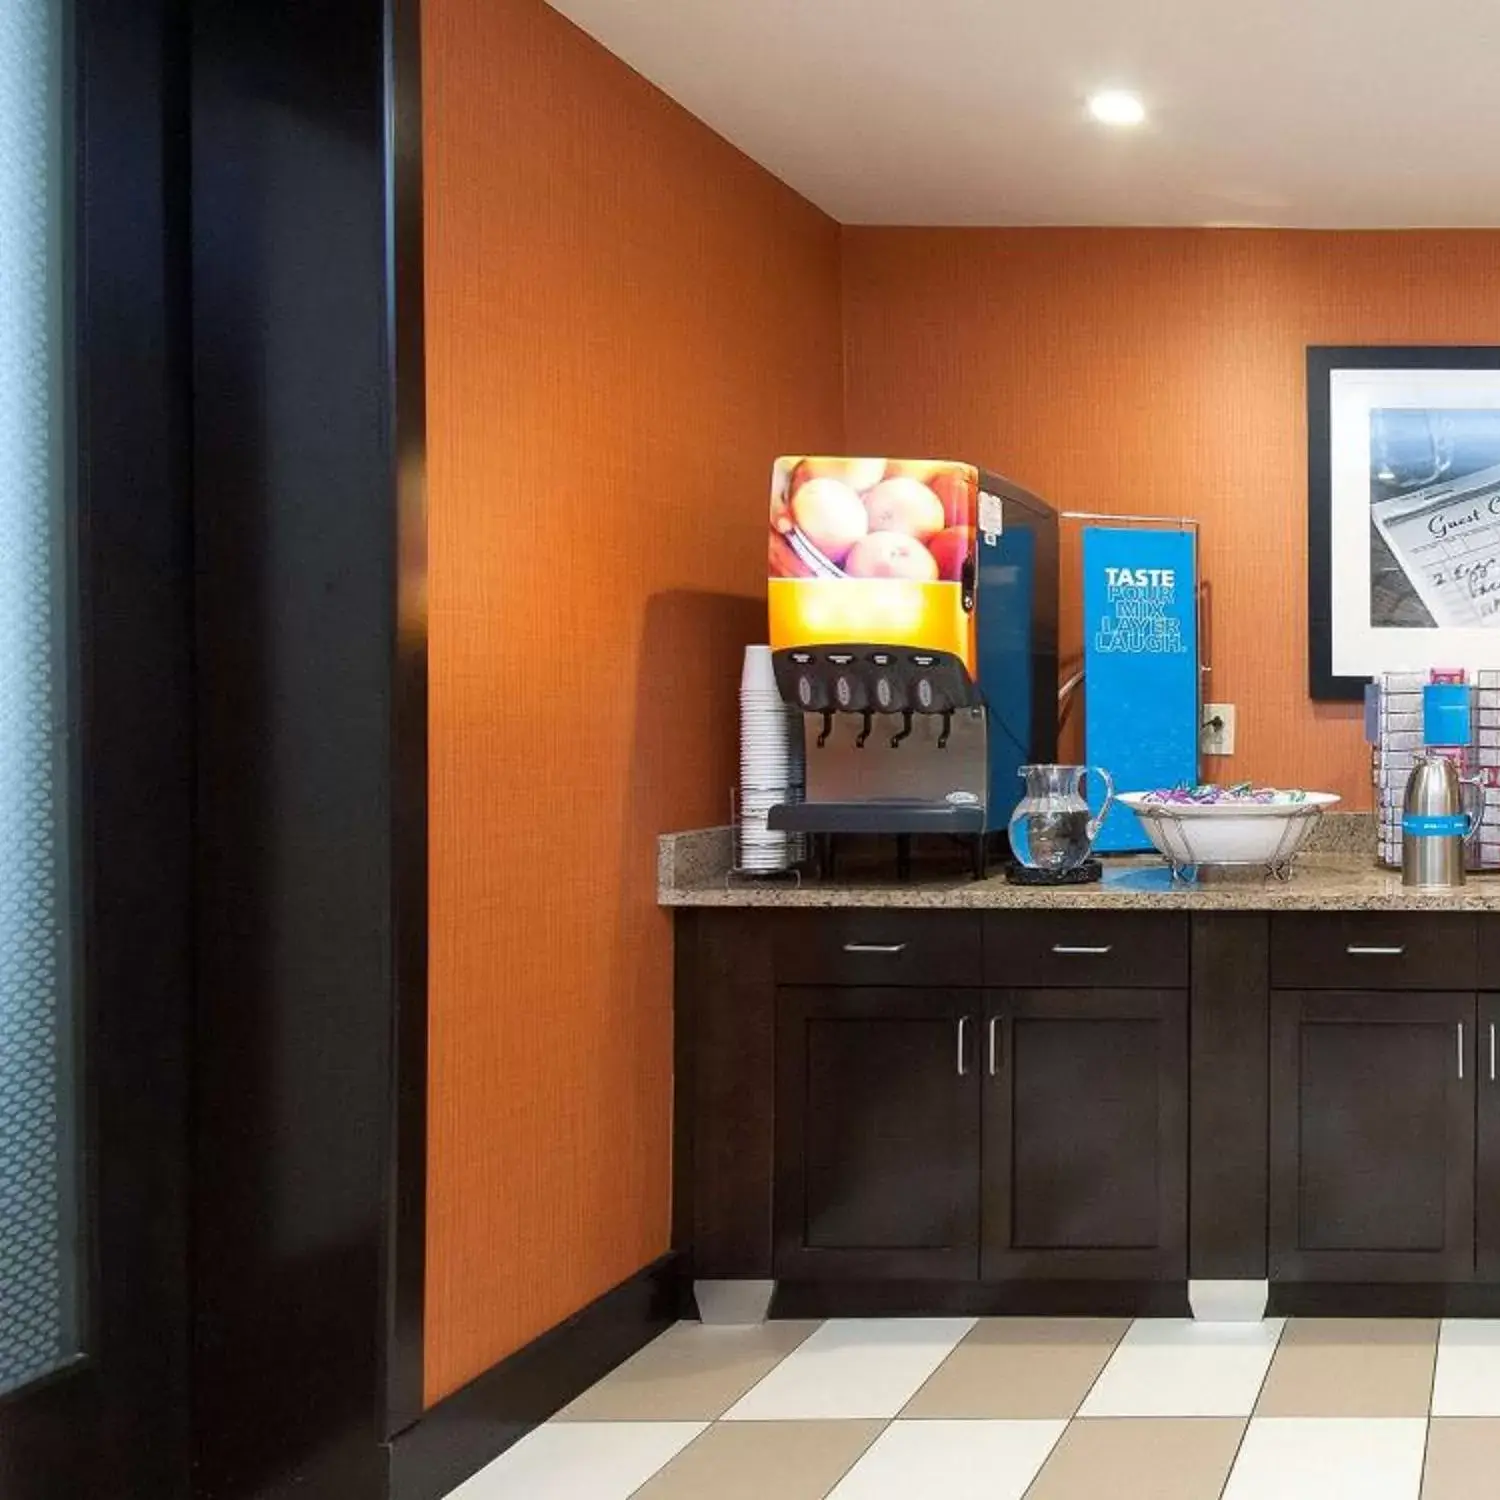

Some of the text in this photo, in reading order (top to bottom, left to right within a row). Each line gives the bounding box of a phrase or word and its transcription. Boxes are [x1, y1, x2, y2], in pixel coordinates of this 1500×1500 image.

[1427, 508, 1480, 538] Guest
[1104, 567, 1176, 588] TASTE
[1107, 586, 1176, 604] POUR
[1115, 600, 1165, 618] MIX
[1101, 616, 1181, 636] LAYER
